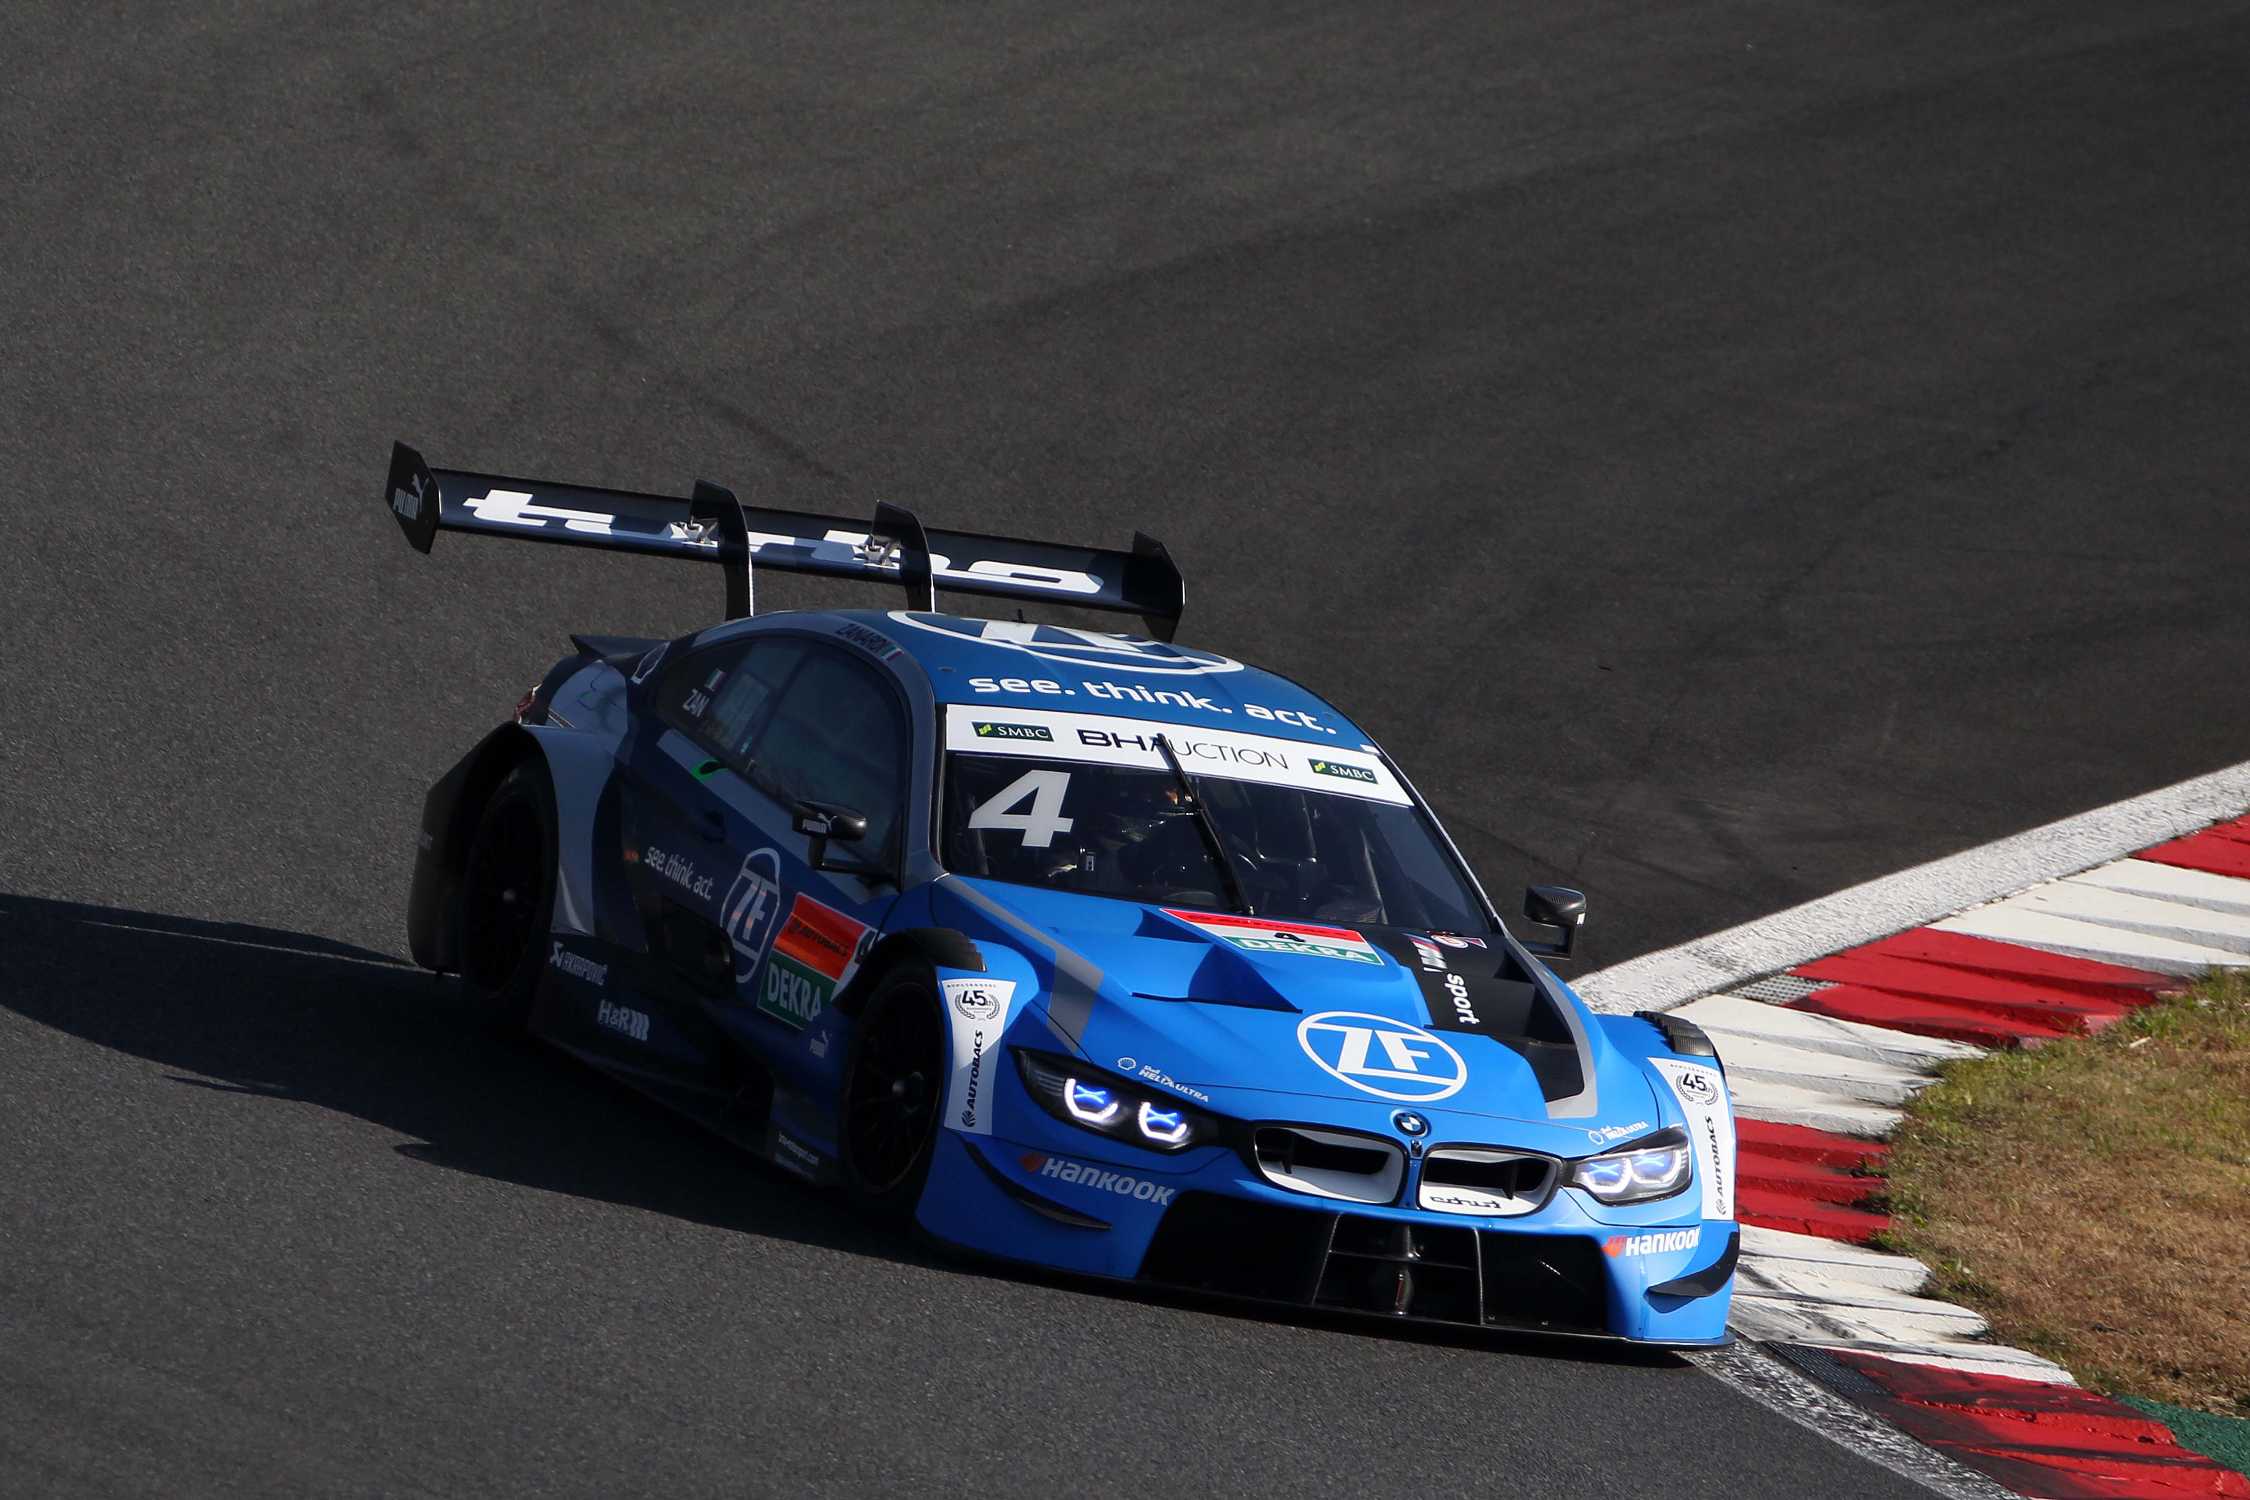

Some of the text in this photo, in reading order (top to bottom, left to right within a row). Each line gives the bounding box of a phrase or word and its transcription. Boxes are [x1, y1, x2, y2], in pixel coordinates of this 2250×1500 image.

[968, 678, 1337, 735] see. think. act.
[997, 724, 1050, 740] SMBC
[1329, 763, 1373, 780] SMBC
[967, 769, 1075, 849] 4
[1241, 939, 1374, 962] DEKRA
[767, 961, 822, 1022] DEKRA
[1444, 973, 1481, 1024] sport
[966, 1029, 984, 1111] AUTOBACS
[1301, 1018, 1461, 1090] ZF
[1705, 1115, 1724, 1198] AUTOBACS
